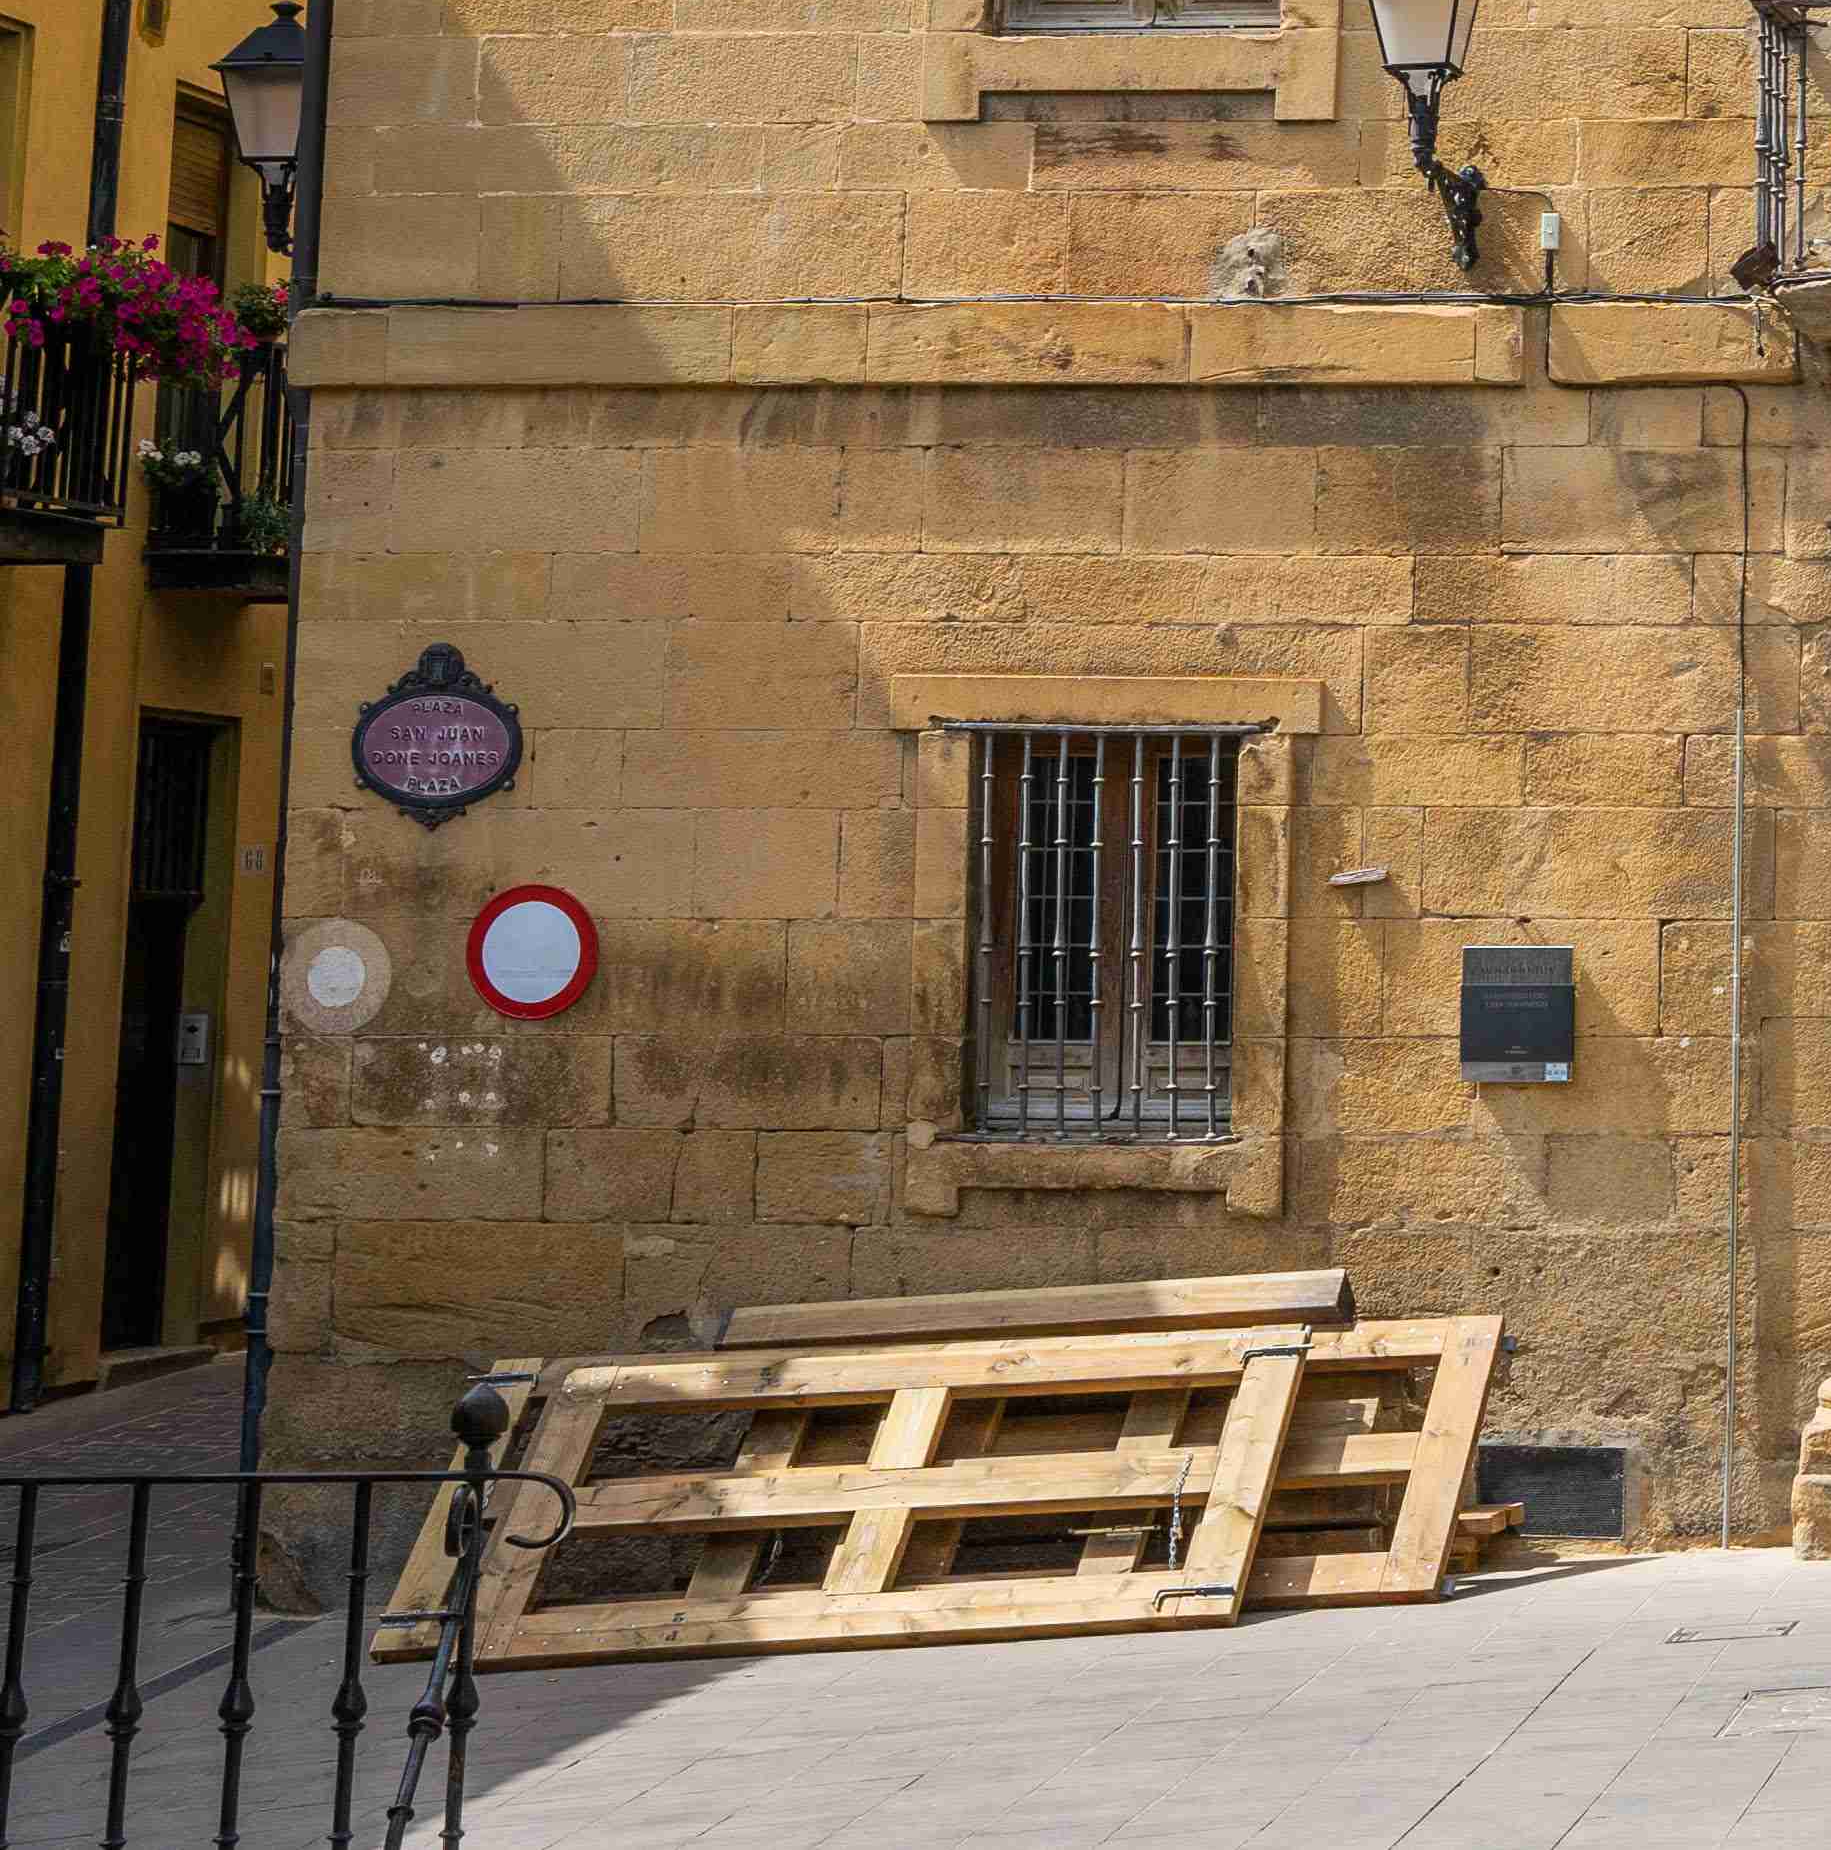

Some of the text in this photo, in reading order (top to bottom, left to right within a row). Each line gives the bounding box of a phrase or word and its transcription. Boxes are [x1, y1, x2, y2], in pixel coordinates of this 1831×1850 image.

[412, 701, 464, 714] PLAZA
[391, 726, 484, 741] SAN JUAN
[372, 751, 499, 766] DONE JOANES
[407, 775, 462, 793] PLAZA
